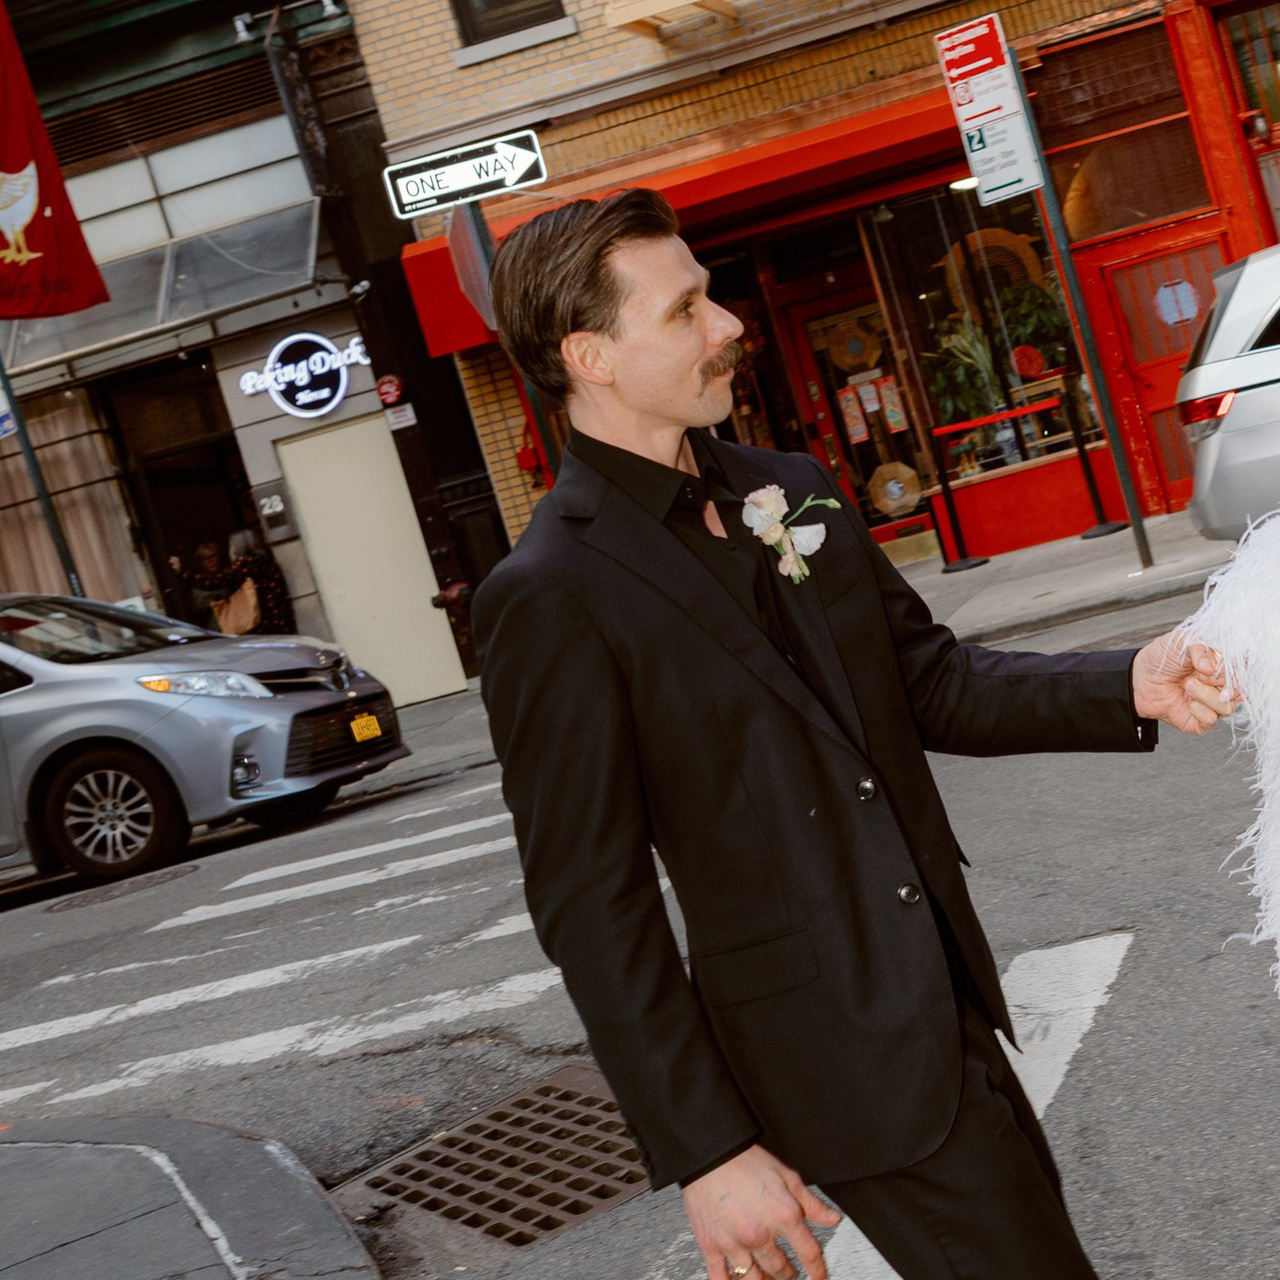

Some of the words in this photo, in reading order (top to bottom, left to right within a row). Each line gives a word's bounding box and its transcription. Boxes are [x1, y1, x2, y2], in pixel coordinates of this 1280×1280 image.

[405, 171, 450, 198] ONE
[472, 152, 518, 180] WAY
[240, 359, 310, 396] Peking
[308, 336, 371, 375] Duck
[259, 494, 284, 516] 28
